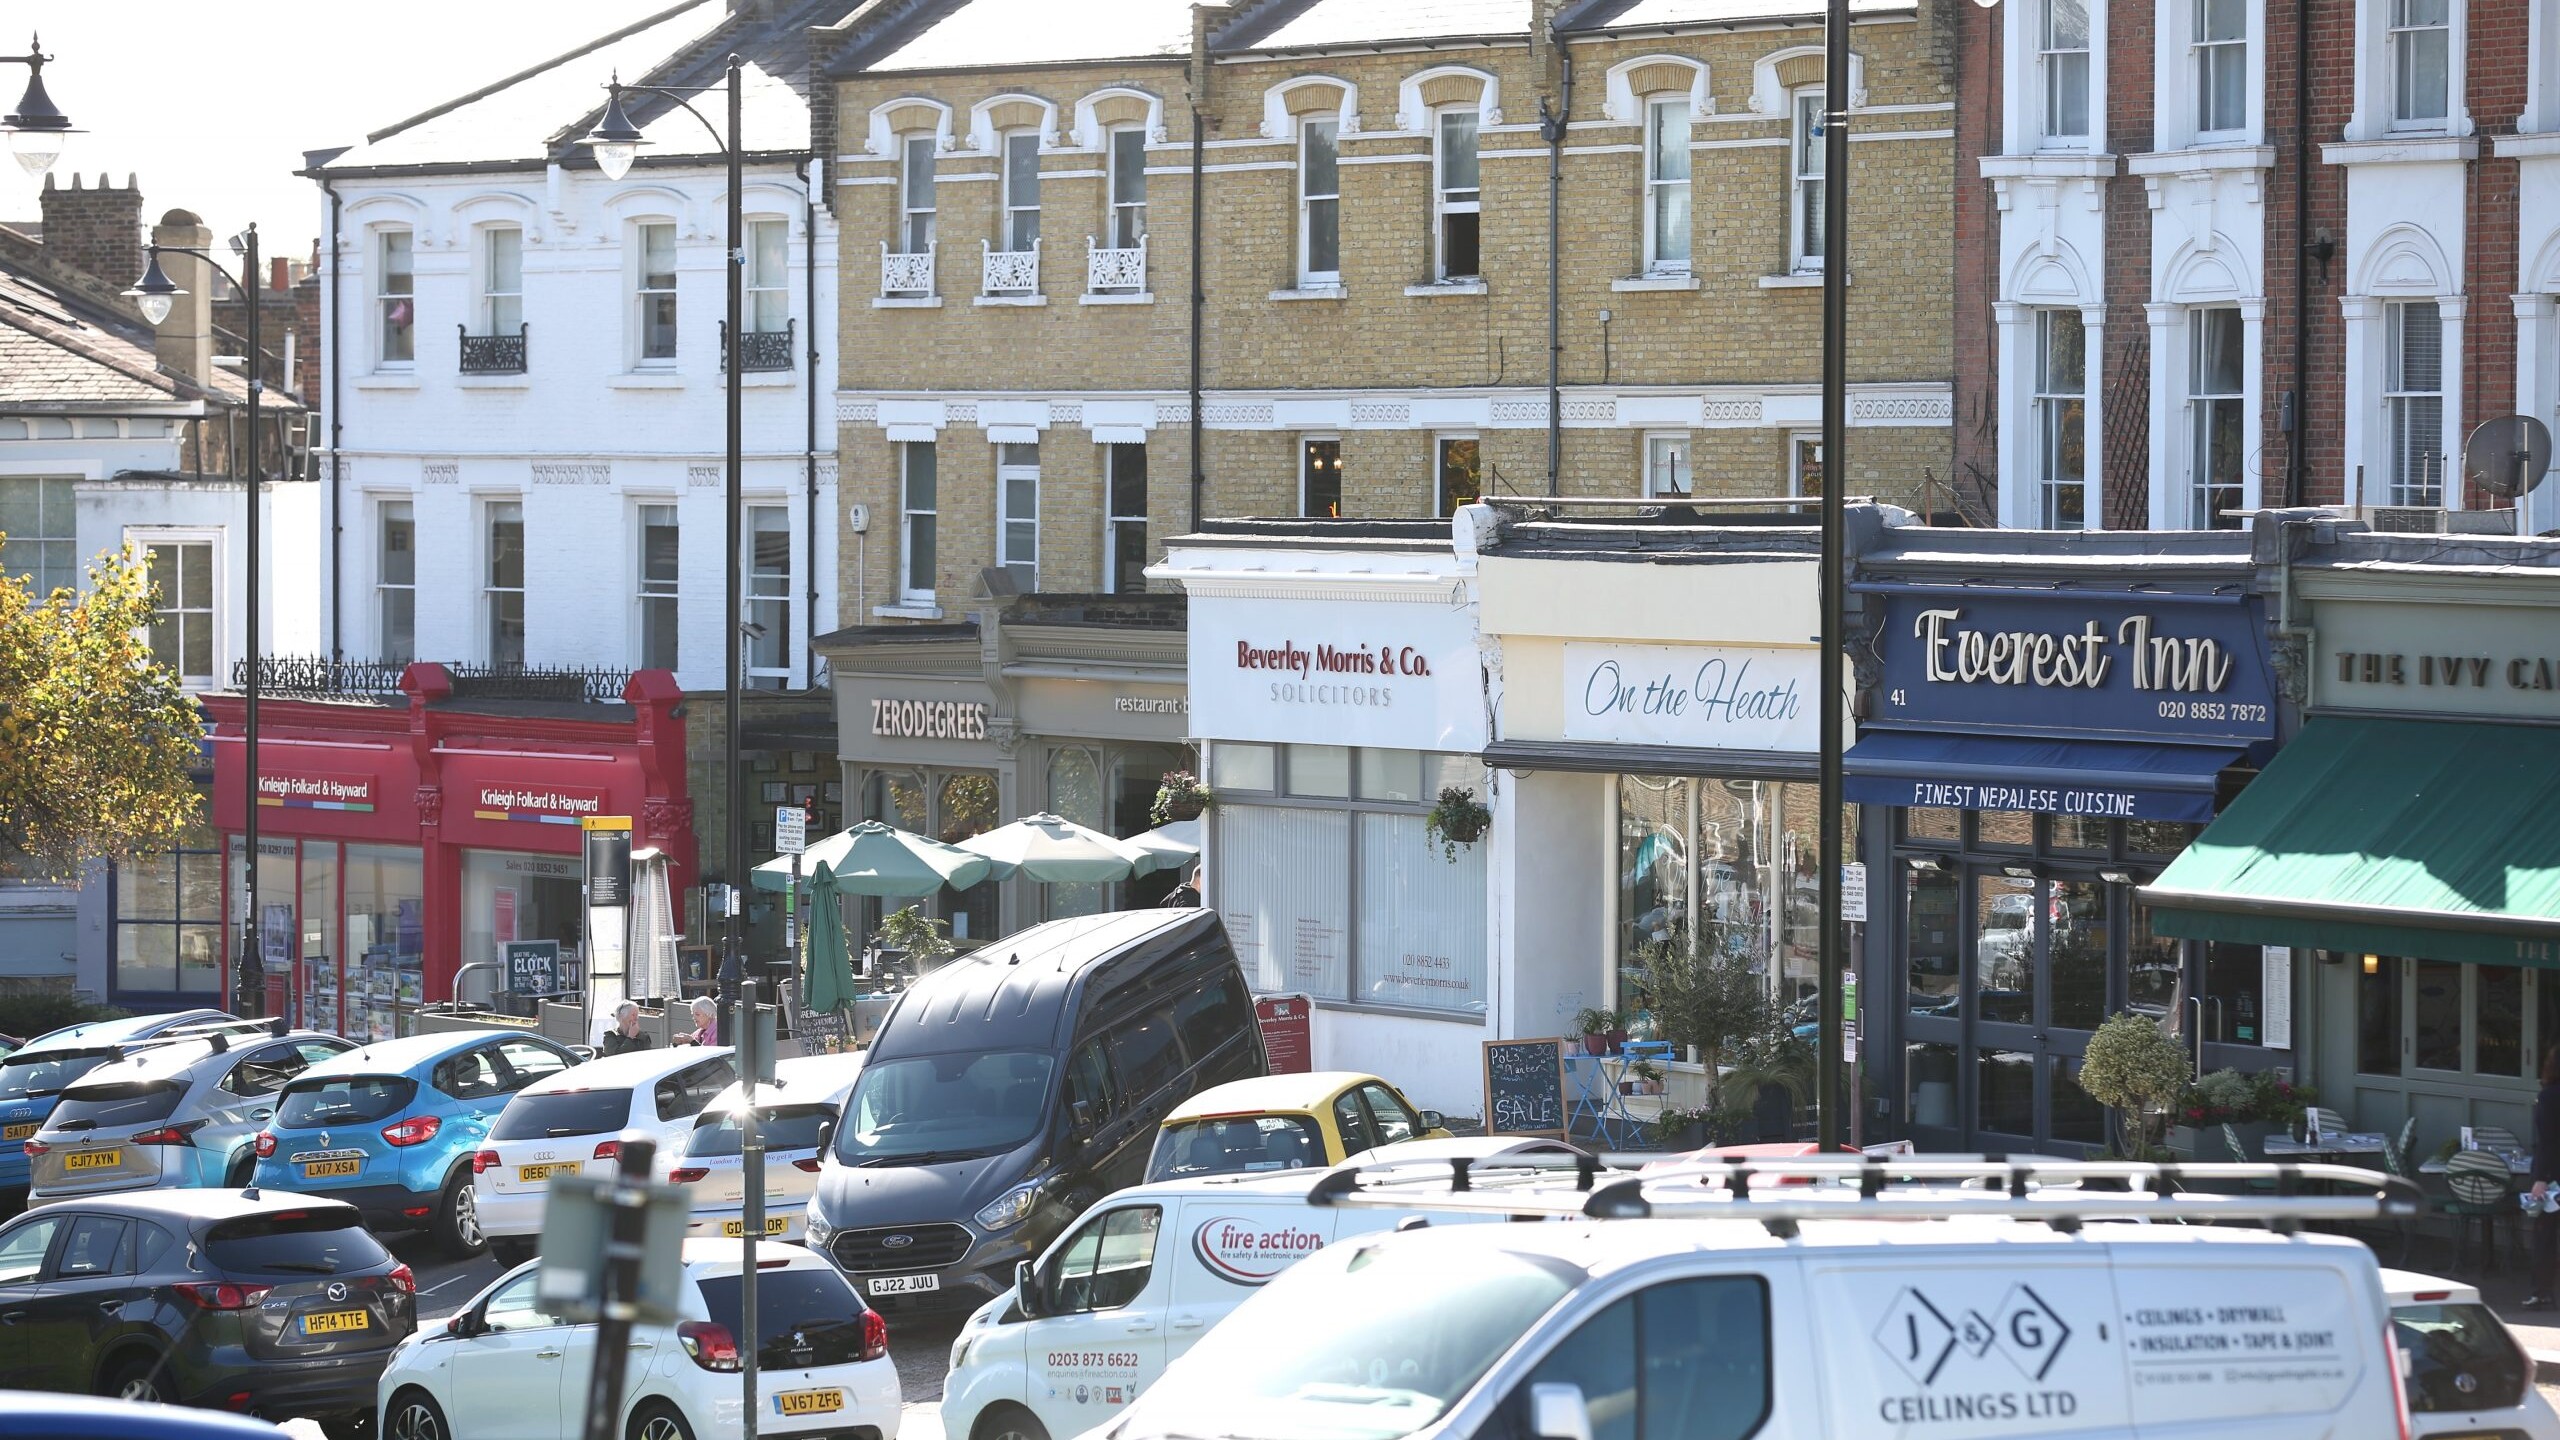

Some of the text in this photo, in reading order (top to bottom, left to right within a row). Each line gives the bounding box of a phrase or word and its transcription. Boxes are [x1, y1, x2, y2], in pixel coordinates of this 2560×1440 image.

[1238, 640, 1430, 680] Beverley Morris & Co.
[1915, 608, 2232, 692] Everest Inn
[2336, 652, 2560, 690] THE IVY CA
[1270, 683, 1392, 706] SOLICITORS
[1585, 658, 1800, 724] On the Heath
[1890, 689, 1906, 706] 41
[872, 699, 984, 740] ZERODEGREES
[2158, 701, 2266, 722] 020 8852 7872
[258, 776, 368, 800] Kinleigh Folkard & Hayward
[482, 789, 598, 814] Kinleigh Folkard & Hayward
[1914, 782, 2136, 816] FINEST NEPALESE CUISINE
[506, 860, 522, 871] Sales
[524, 861, 535, 872] 020
[514, 956, 551, 974] CLOCK
[1417, 955, 1432, 968] 8852
[1496, 1098, 1554, 1124] SALE
[7, 1126, 28, 1138] SA17
[71, 1153, 114, 1167] GJ17 XYN
[309, 1162, 354, 1175] LX17 XSA
[727, 1219, 782, 1234] GD OR
[888, 1236, 905, 1246] Ford
[1222, 1224, 1321, 1250] fire action
[1232, 1251, 1252, 1261] safety
[873, 1276, 933, 1292] GJ22 JUU
[310, 1313, 362, 1330] HF14 TTE
[2135, 1305, 2286, 1326] CEILINGS DRYWALL
[1906, 1308, 2043, 1361] J & G
[2141, 1335, 2229, 1353] INSULATION
[2243, 1333, 2278, 1350] TAPE
[1048, 1353, 1138, 1366] 0203 873 6622
[782, 1393, 841, 1411] LV67 ZFG
[1880, 1391, 2078, 1424] CEILINGS LTD
